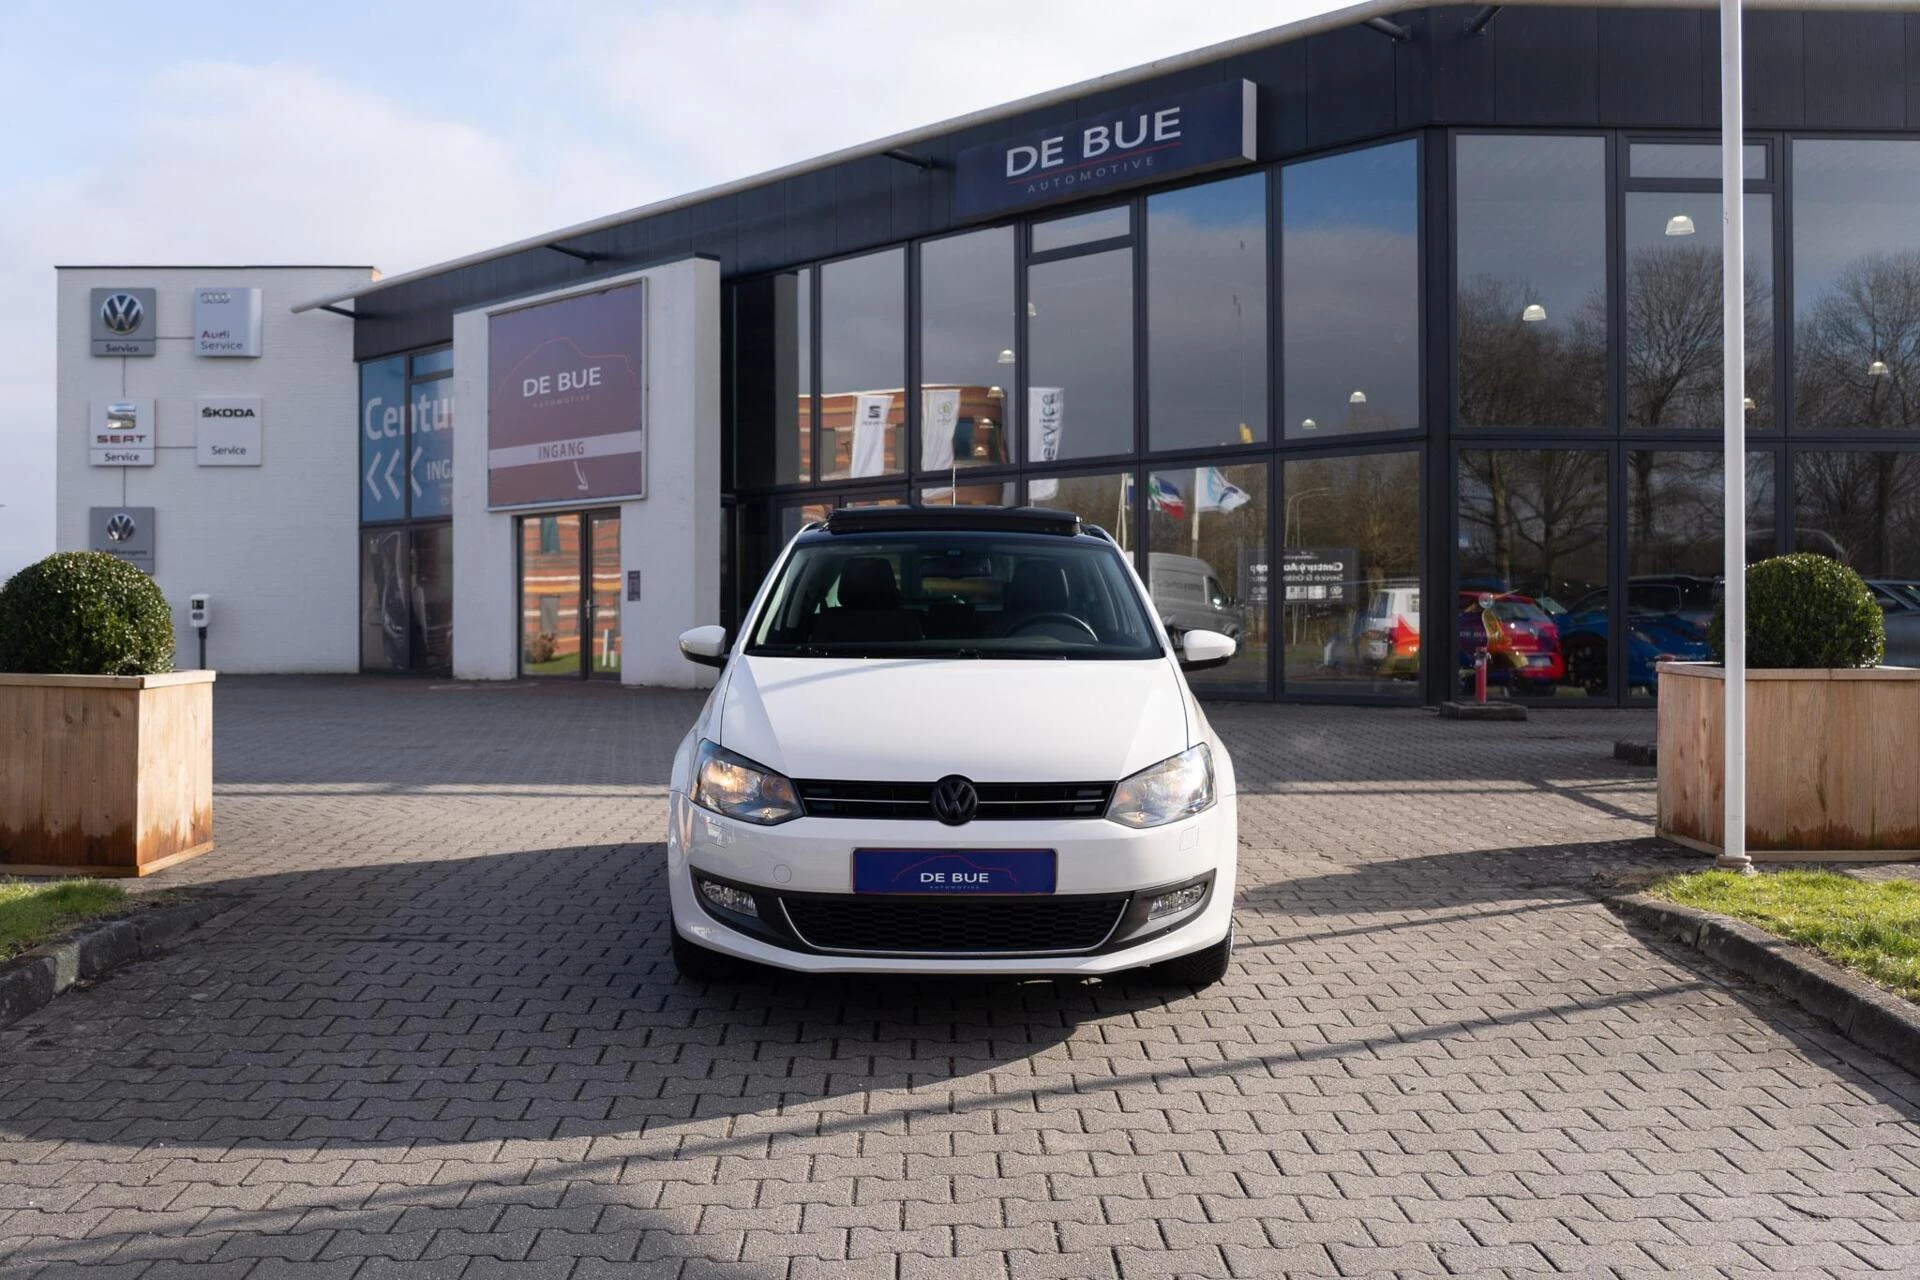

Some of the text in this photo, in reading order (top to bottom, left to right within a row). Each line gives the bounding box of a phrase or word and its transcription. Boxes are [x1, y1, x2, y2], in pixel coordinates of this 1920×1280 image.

[1006, 106, 1182, 177] DE BUE
[1027, 156, 1154, 193] AUTOMOTIVE
[201, 330, 230, 339] Audi
[106, 343, 140, 352] Service
[201, 341, 243, 350] Service
[523, 366, 602, 397] DE BUE
[202, 406, 256, 418] ŠKODA
[1039, 393, 1058, 461] ervice
[97, 435, 146, 443] SEAT
[212, 445, 247, 456] Service
[538, 441, 585, 459] INGANG
[104, 452, 140, 462] Service
[426, 459, 454, 481] ING
[920, 872, 989, 883] DE BUE
